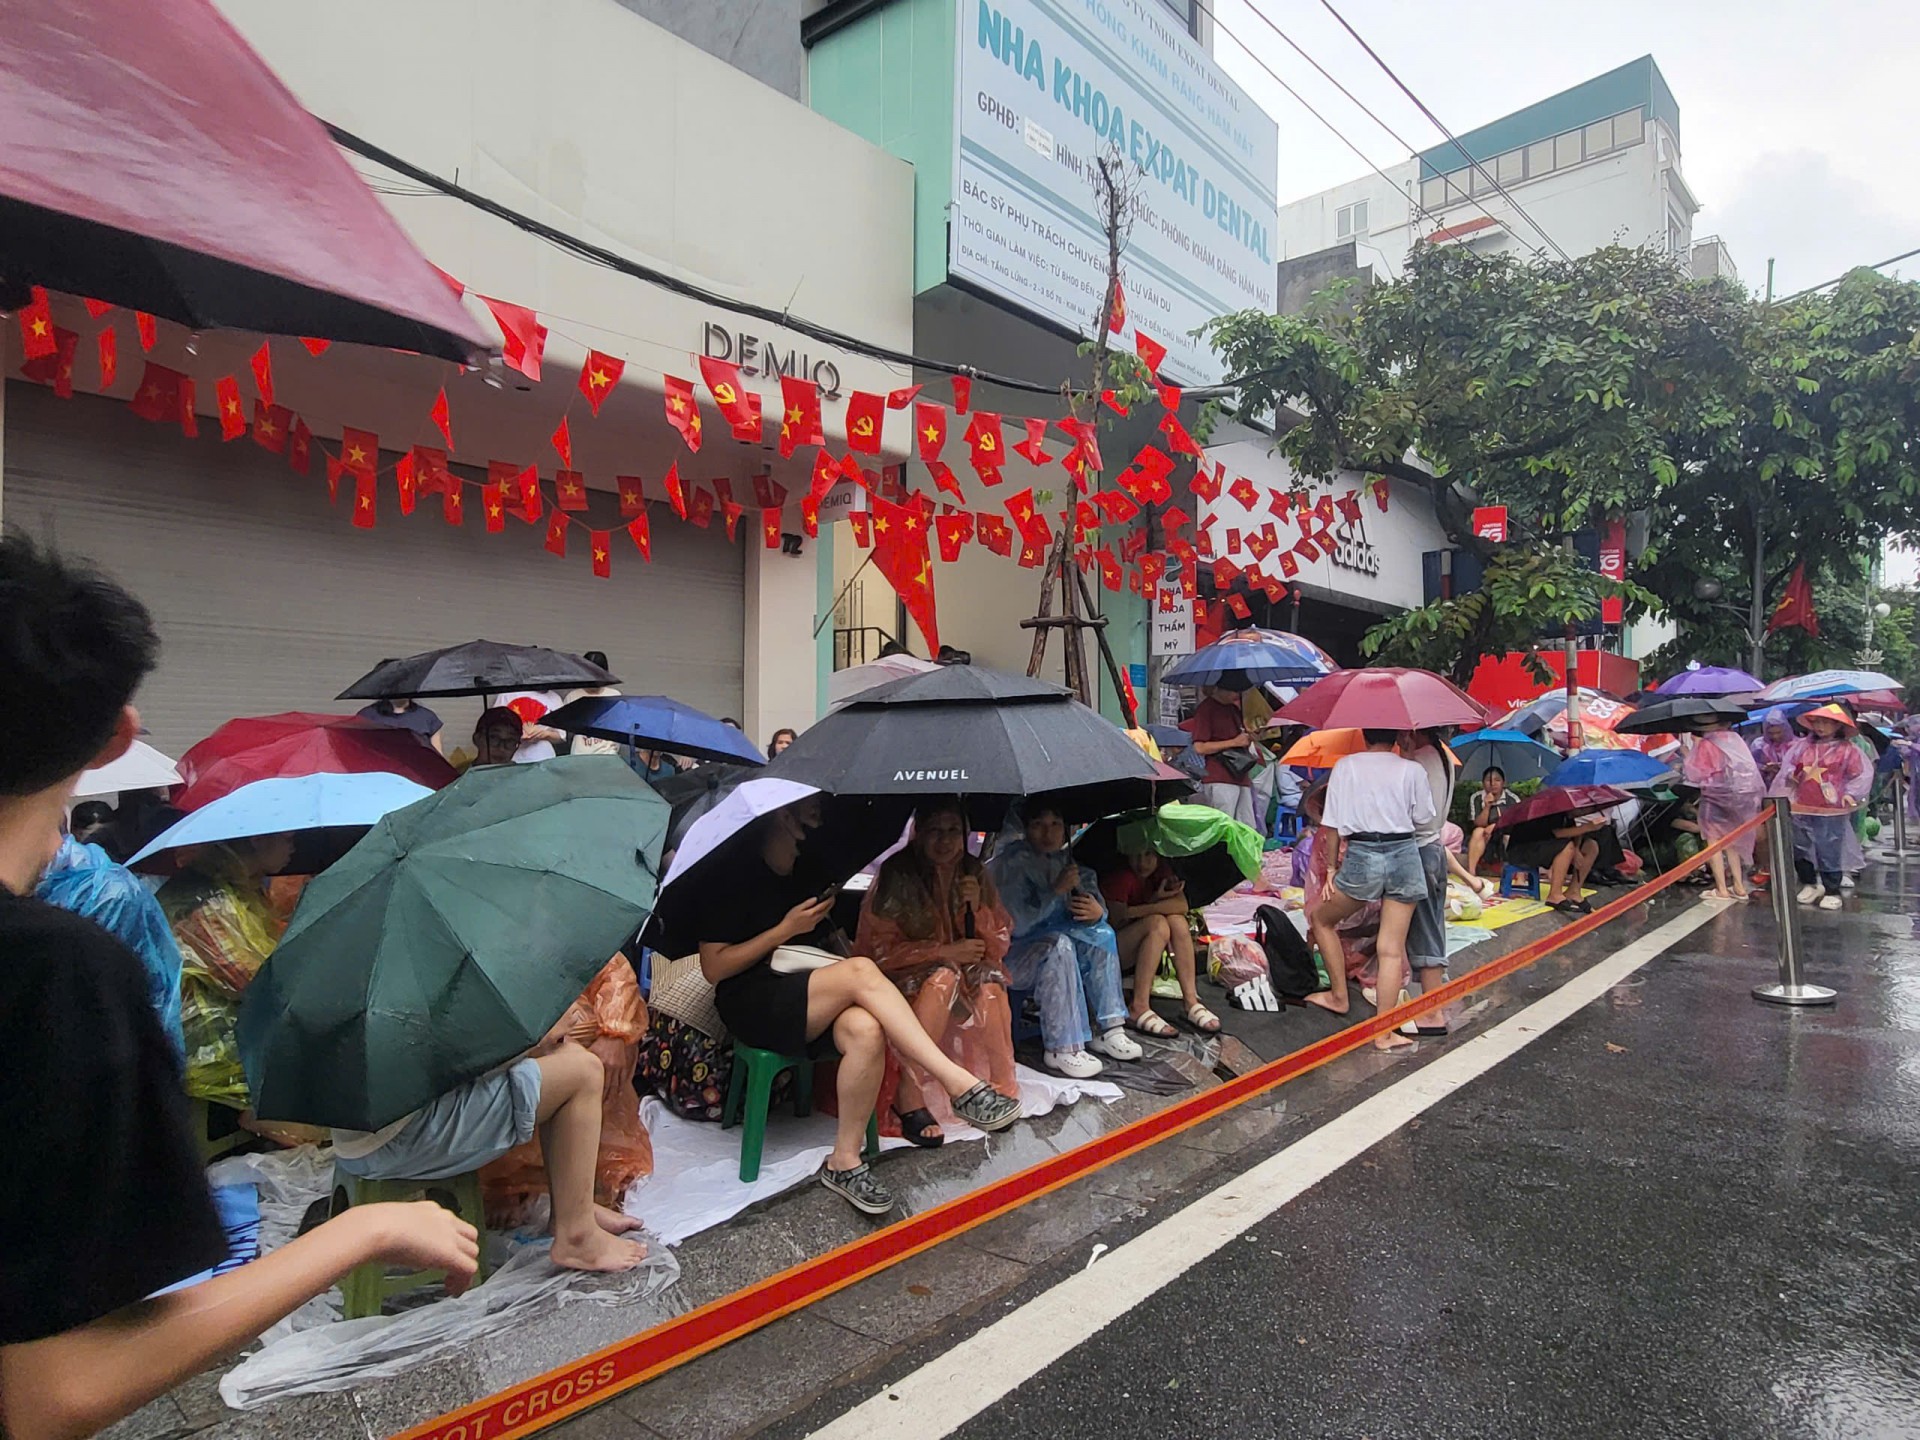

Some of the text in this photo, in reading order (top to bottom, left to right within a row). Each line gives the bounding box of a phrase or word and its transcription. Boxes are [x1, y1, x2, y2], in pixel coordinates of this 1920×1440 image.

[1178, 44, 1205, 79] EXPAT
[1207, 72, 1240, 113] DENTAL
[978, 0, 1271, 266] NHA KHOA EXPAT DENTAL
[978, 91, 1020, 134] GPHĐ:
[1056, 143, 1083, 177] HÌNH
[1161, 219, 1190, 252] PHÒNG
[1192, 240, 1215, 272] KHÁM
[962, 214, 984, 236] THỜI
[986, 228, 1007, 248] GIAN
[1009, 240, 1026, 259] LÀM
[963, 179, 988, 205] BÁC
[1007, 205, 1029, 232] PHỤ
[1031, 219, 1066, 252] TRÁCH
[1067, 241, 1105, 275] CHUYÊN
[1160, 299, 1172, 313] DU
[702, 321, 843, 401] DEMIQ
[820, 492, 852, 509] EMIQ
[1333, 540, 1380, 577] adidas
[893, 769, 969, 781] AVENUEL
[502, 1360, 616, 1427] CROSS
